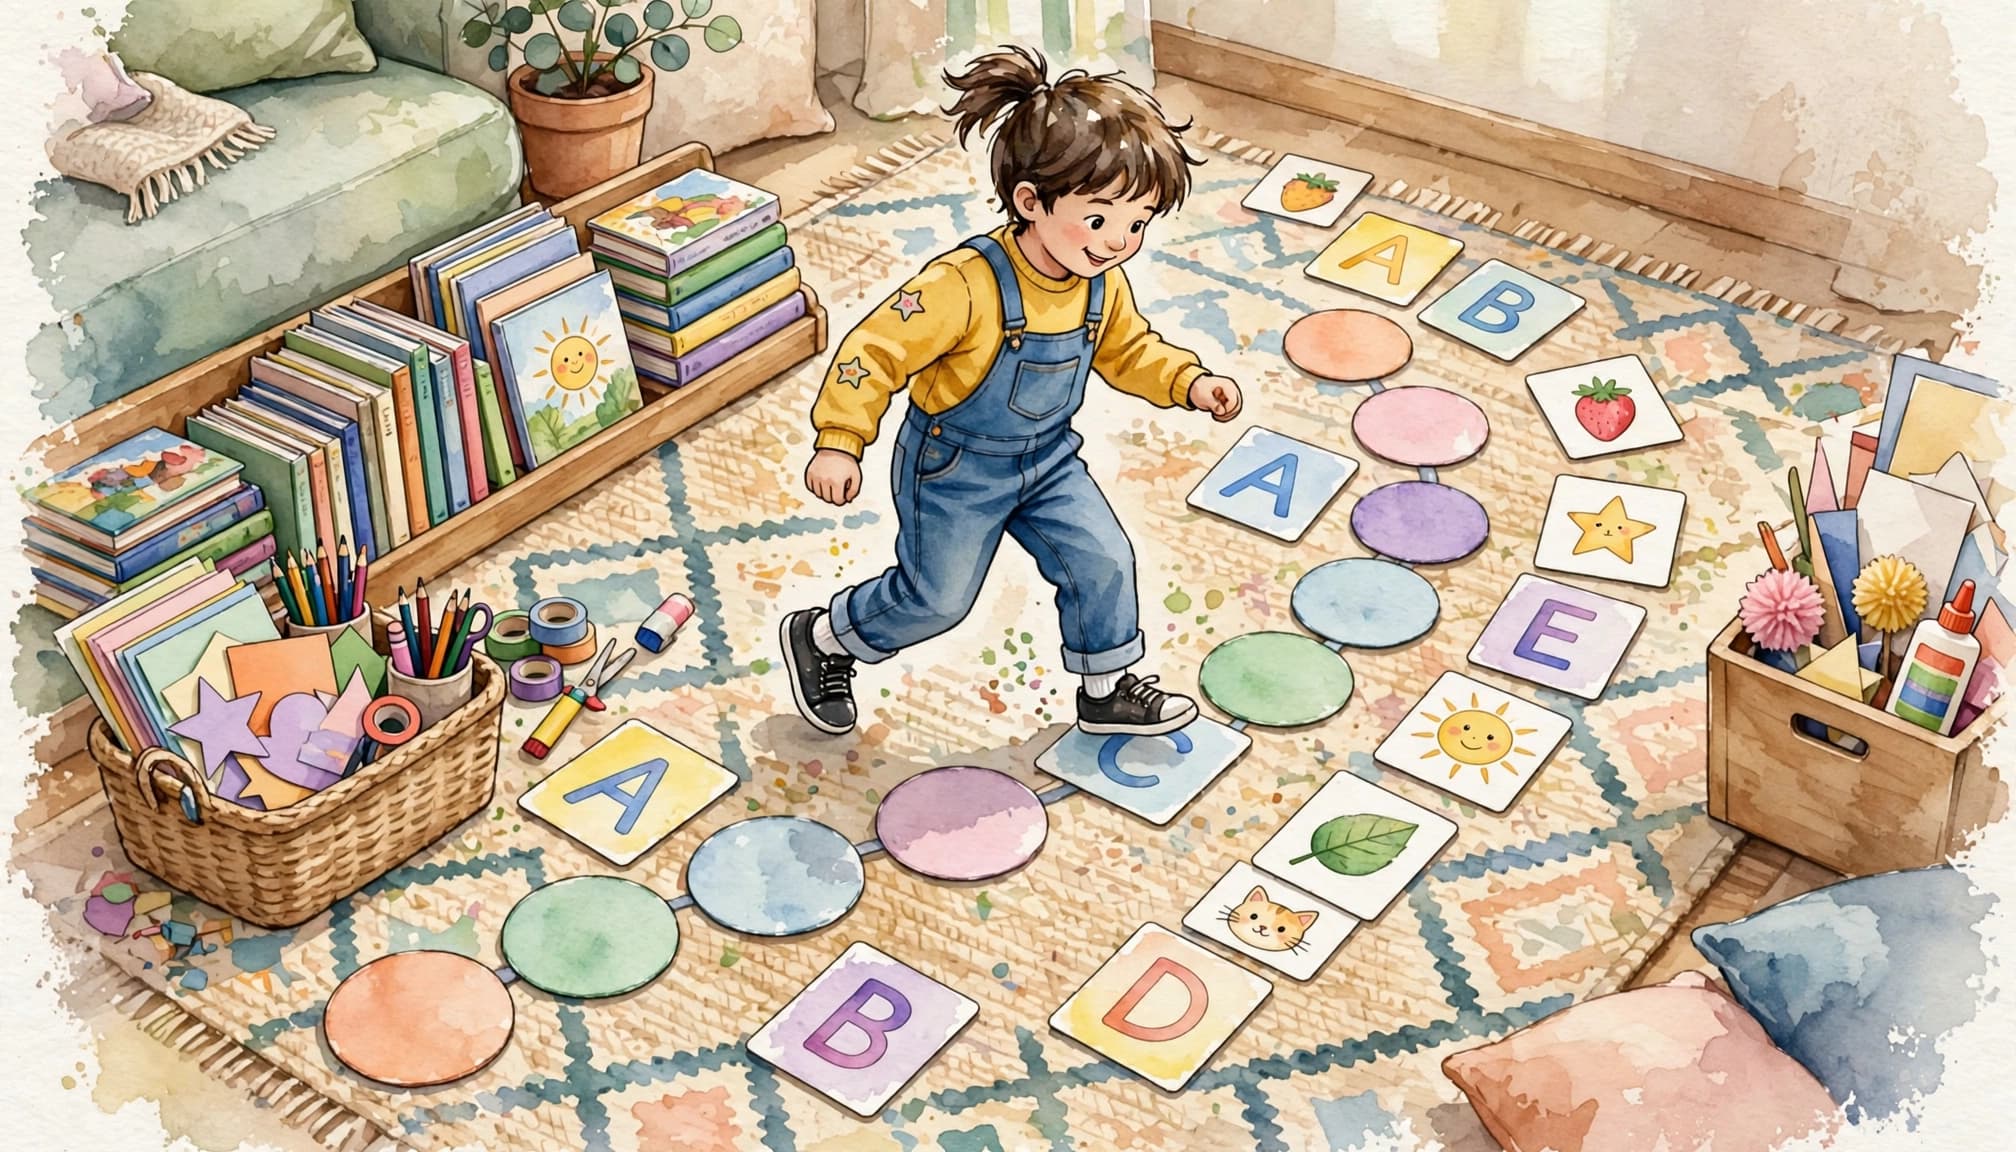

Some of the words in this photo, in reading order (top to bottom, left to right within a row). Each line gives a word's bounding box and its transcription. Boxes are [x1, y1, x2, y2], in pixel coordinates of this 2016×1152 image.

[1338, 234, 1408, 286] A
[1457, 280, 1535, 334] B
[1219, 453, 1299, 519] A
[1513, 598, 1598, 671] E
[1098, 731, 1193, 788] C
[563, 757, 669, 835] A
[803, 978, 912, 1070] B
[1102, 957, 1209, 1043] D
